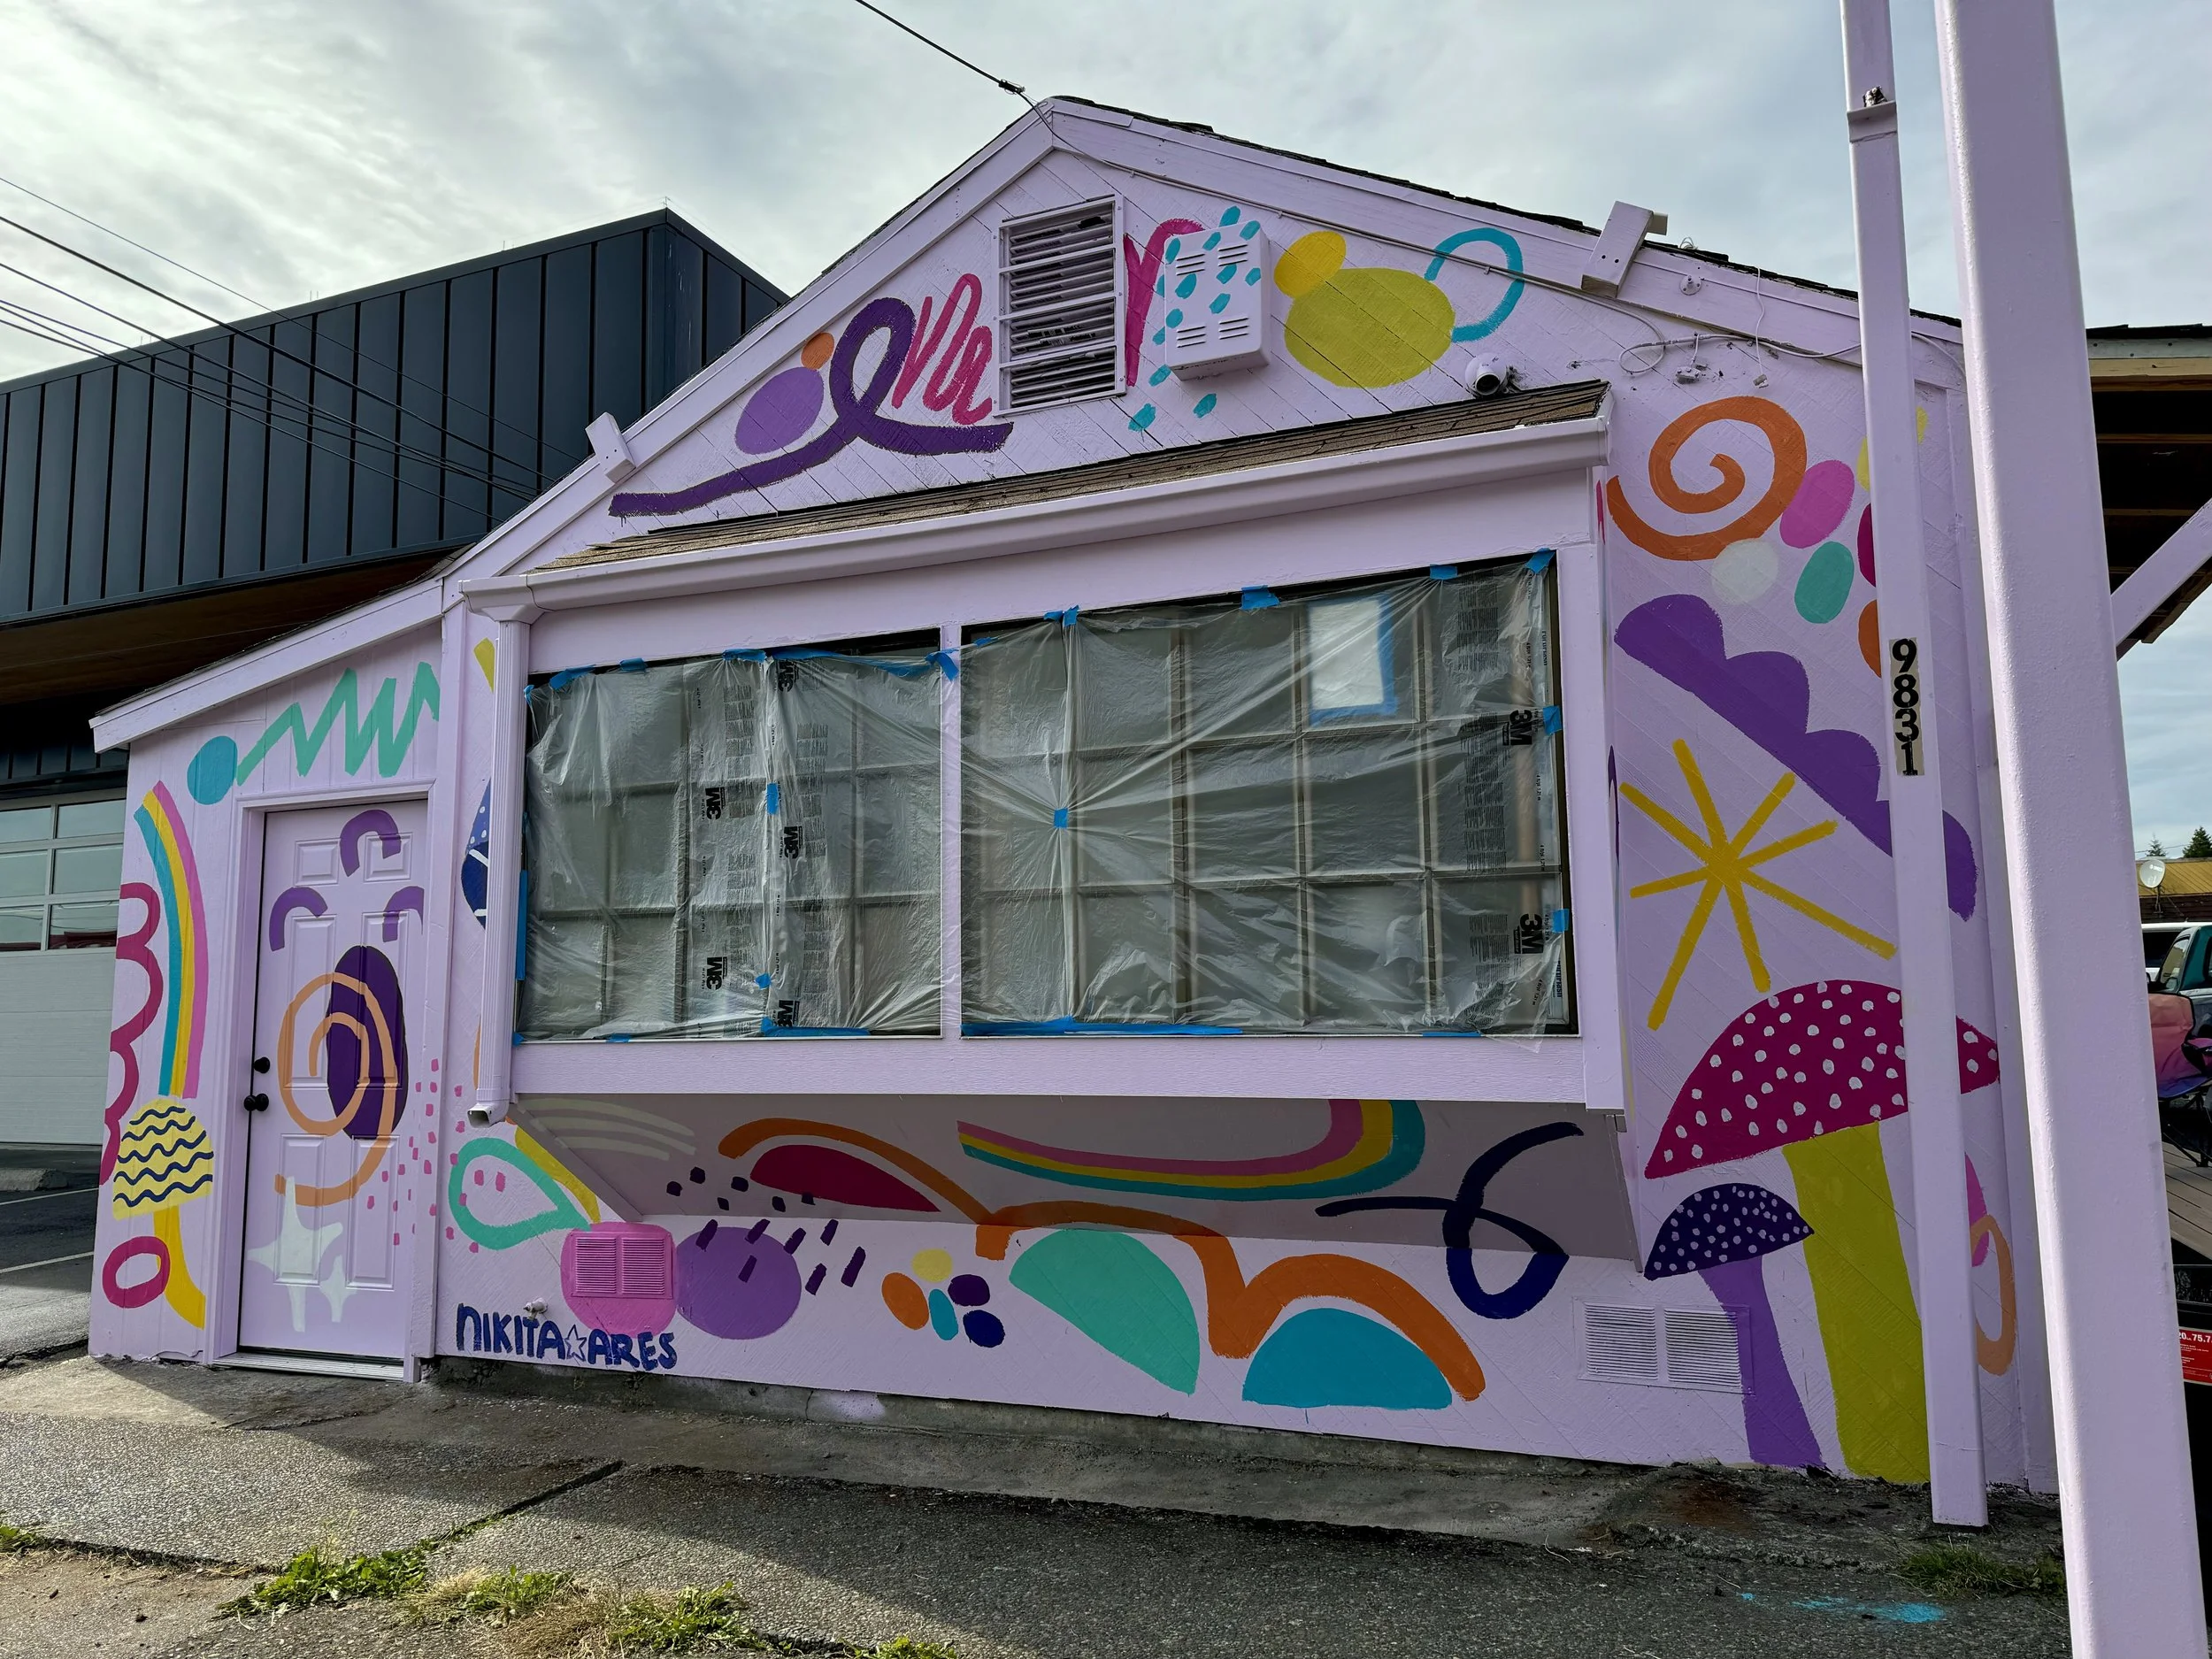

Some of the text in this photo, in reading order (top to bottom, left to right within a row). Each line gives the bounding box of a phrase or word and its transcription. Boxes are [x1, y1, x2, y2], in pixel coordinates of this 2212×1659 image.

[779, 661, 794, 692] 3M
[1892, 638, 1919, 776] 9831
[1509, 710, 1532, 745] 3M
[705, 787, 721, 819] 3M
[784, 826, 798, 858] 3M
[1520, 914, 1543, 954] 3M
[707, 956, 722, 990] 3M
[457, 1302, 678, 1371] NIKITA ARES
